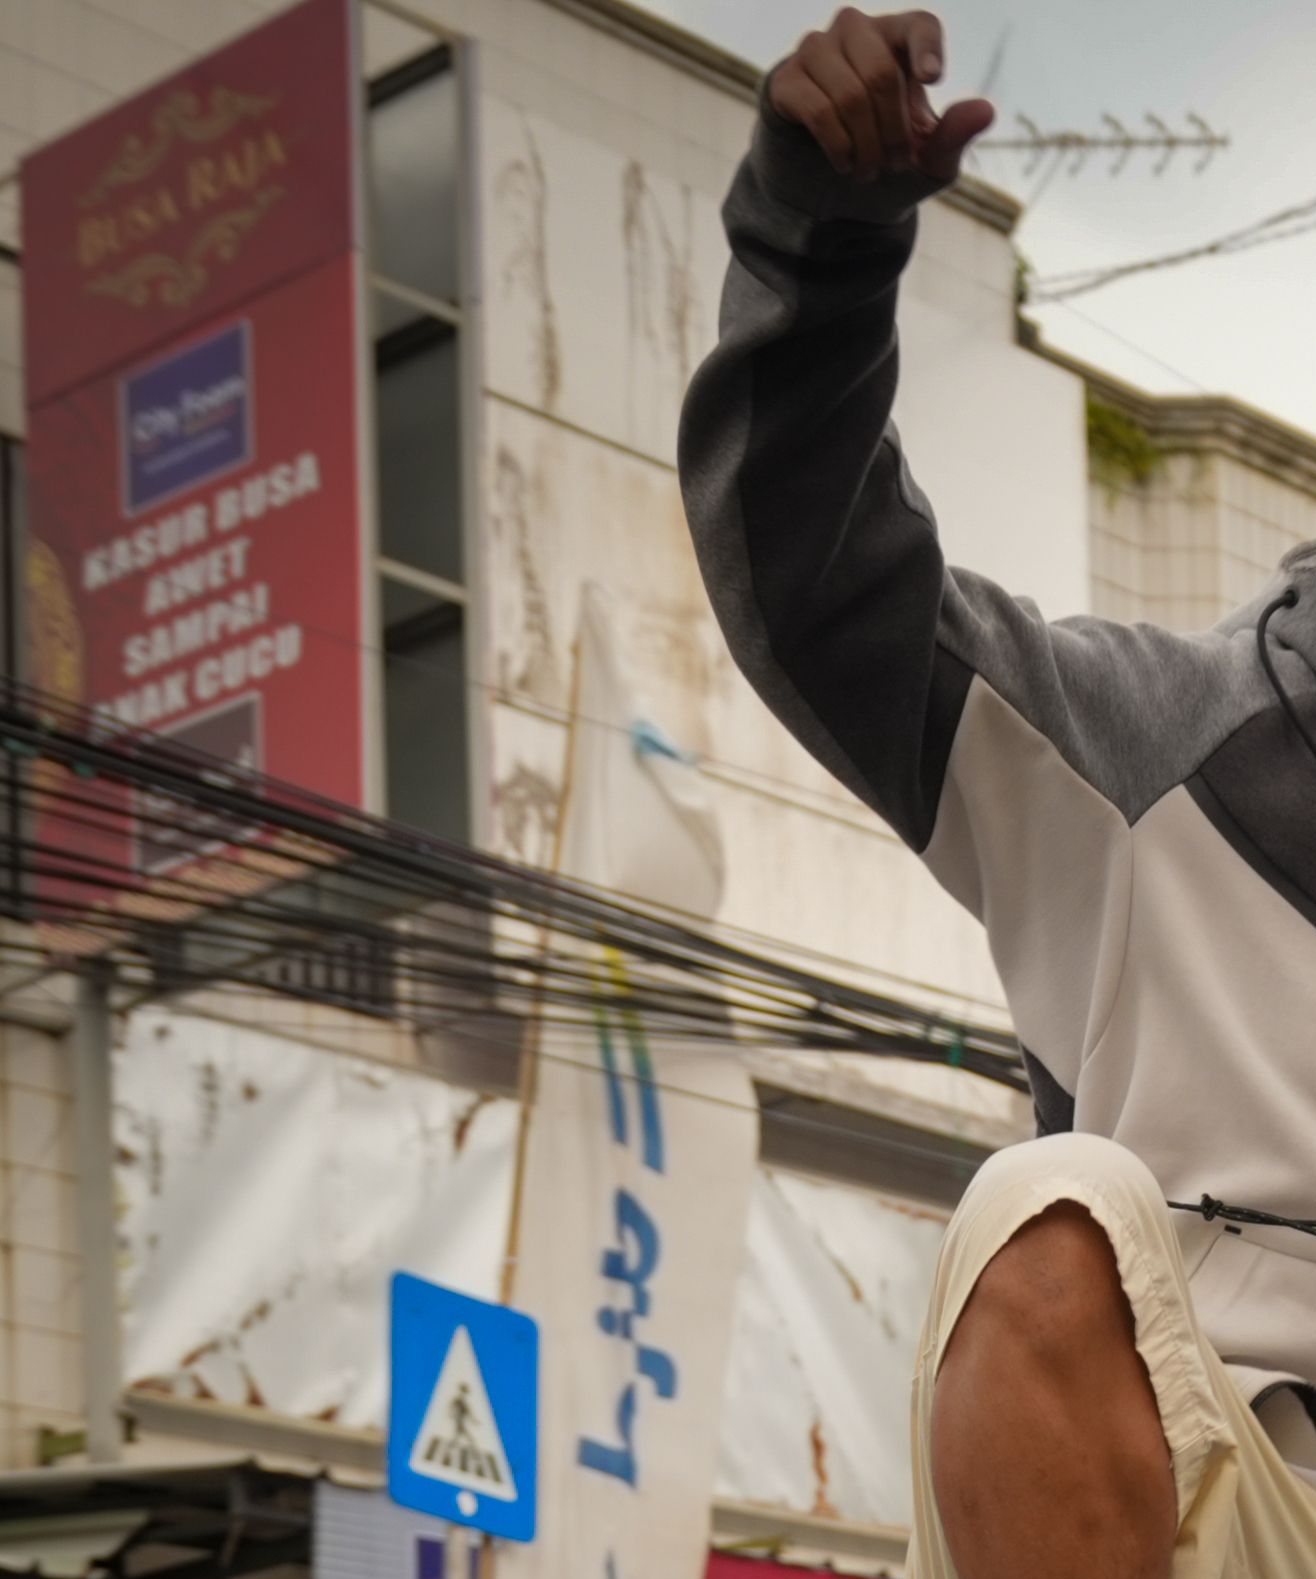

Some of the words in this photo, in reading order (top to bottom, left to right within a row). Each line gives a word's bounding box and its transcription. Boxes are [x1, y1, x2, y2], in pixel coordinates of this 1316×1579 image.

[186, 129, 288, 211] RAJA
[82, 502, 209, 592] KASUR
[214, 451, 321, 532] BUSA
[143, 537, 252, 617] AWET
[122, 582, 270, 677] SAMPAI
[192, 623, 303, 699] CUCU
